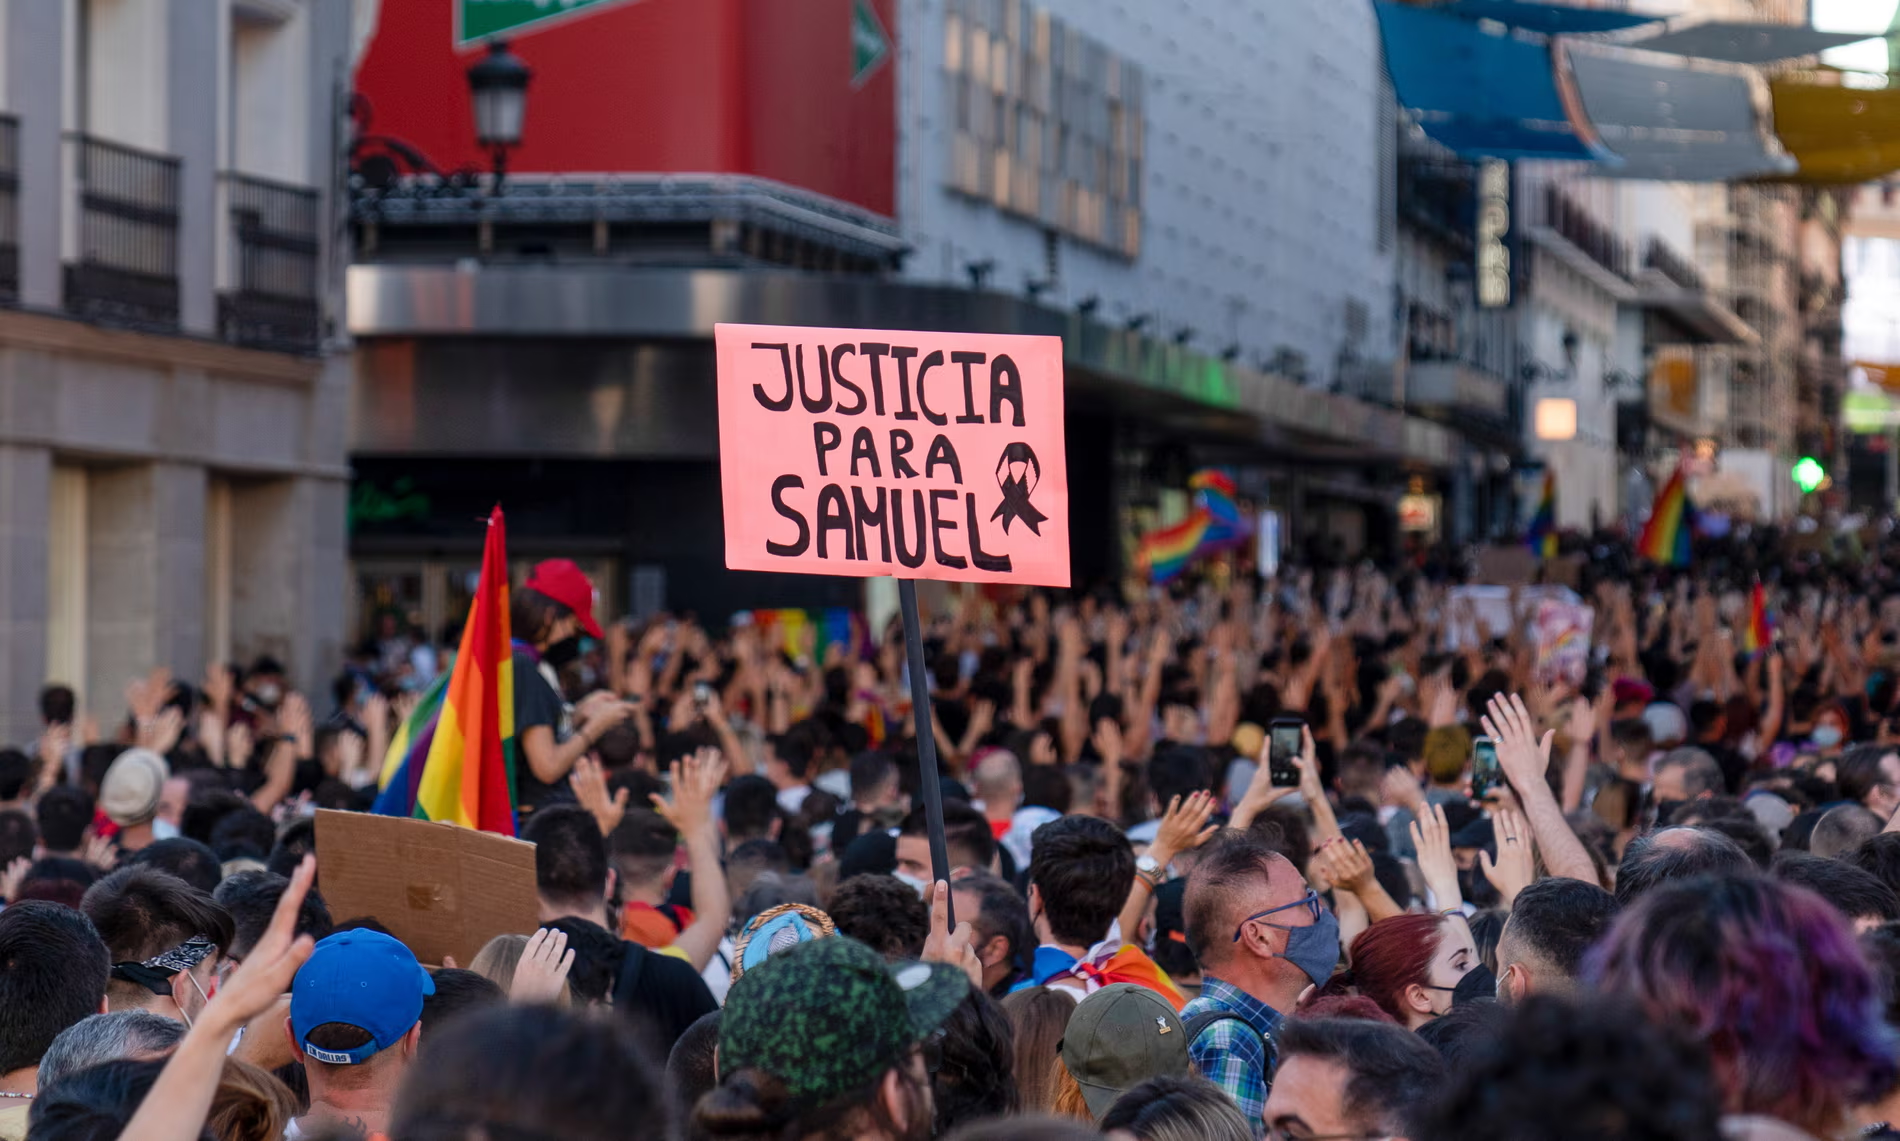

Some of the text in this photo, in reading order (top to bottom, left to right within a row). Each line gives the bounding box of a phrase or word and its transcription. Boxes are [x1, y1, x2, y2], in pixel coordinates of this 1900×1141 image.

[751, 342, 1026, 427] JUSTICIA
[813, 421, 963, 485] PARA
[765, 474, 1013, 573] SAMUEL
[318, 1051, 347, 1062] DALLAS
